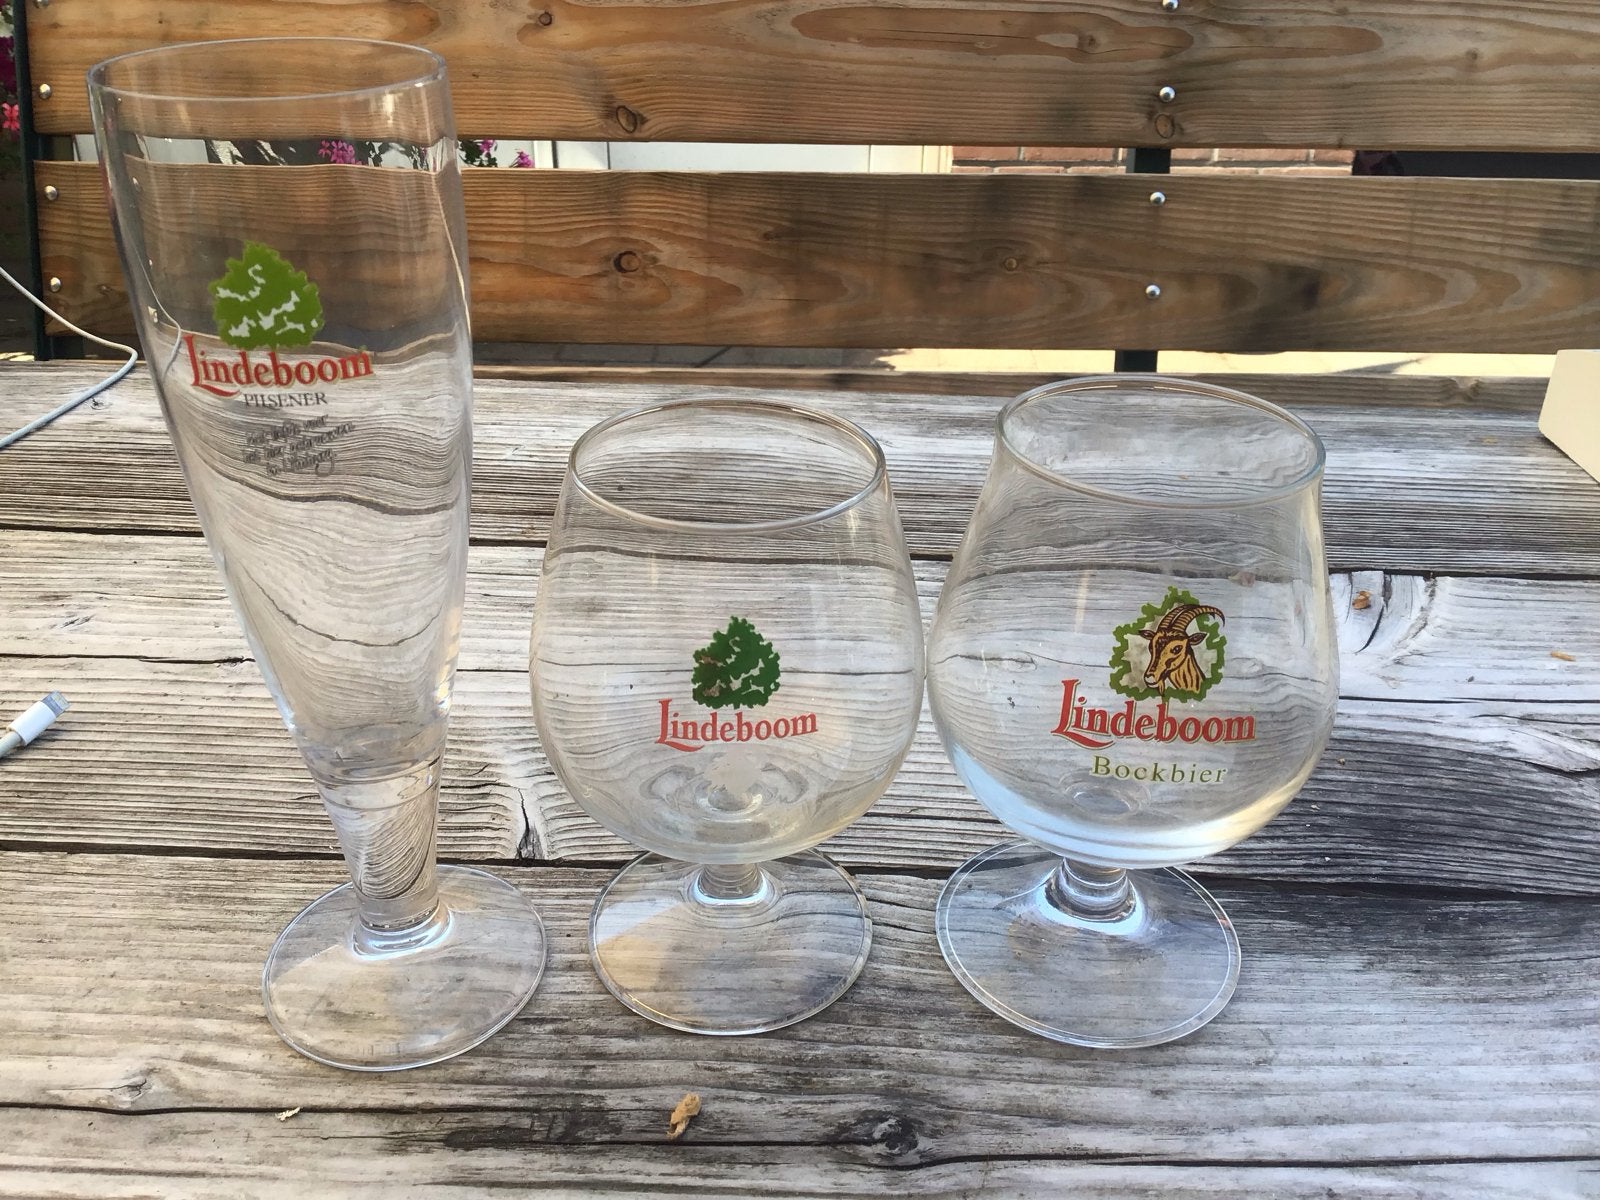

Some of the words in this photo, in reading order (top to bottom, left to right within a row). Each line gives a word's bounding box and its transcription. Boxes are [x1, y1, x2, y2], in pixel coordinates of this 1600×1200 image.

[183, 334, 374, 397] Lindeboom
[243, 391, 328, 410] PILSENER
[655, 698, 819, 752] Lindeboom
[1050, 679, 1256, 748] Lindeboom
[1091, 754, 1228, 784] Bockbier
